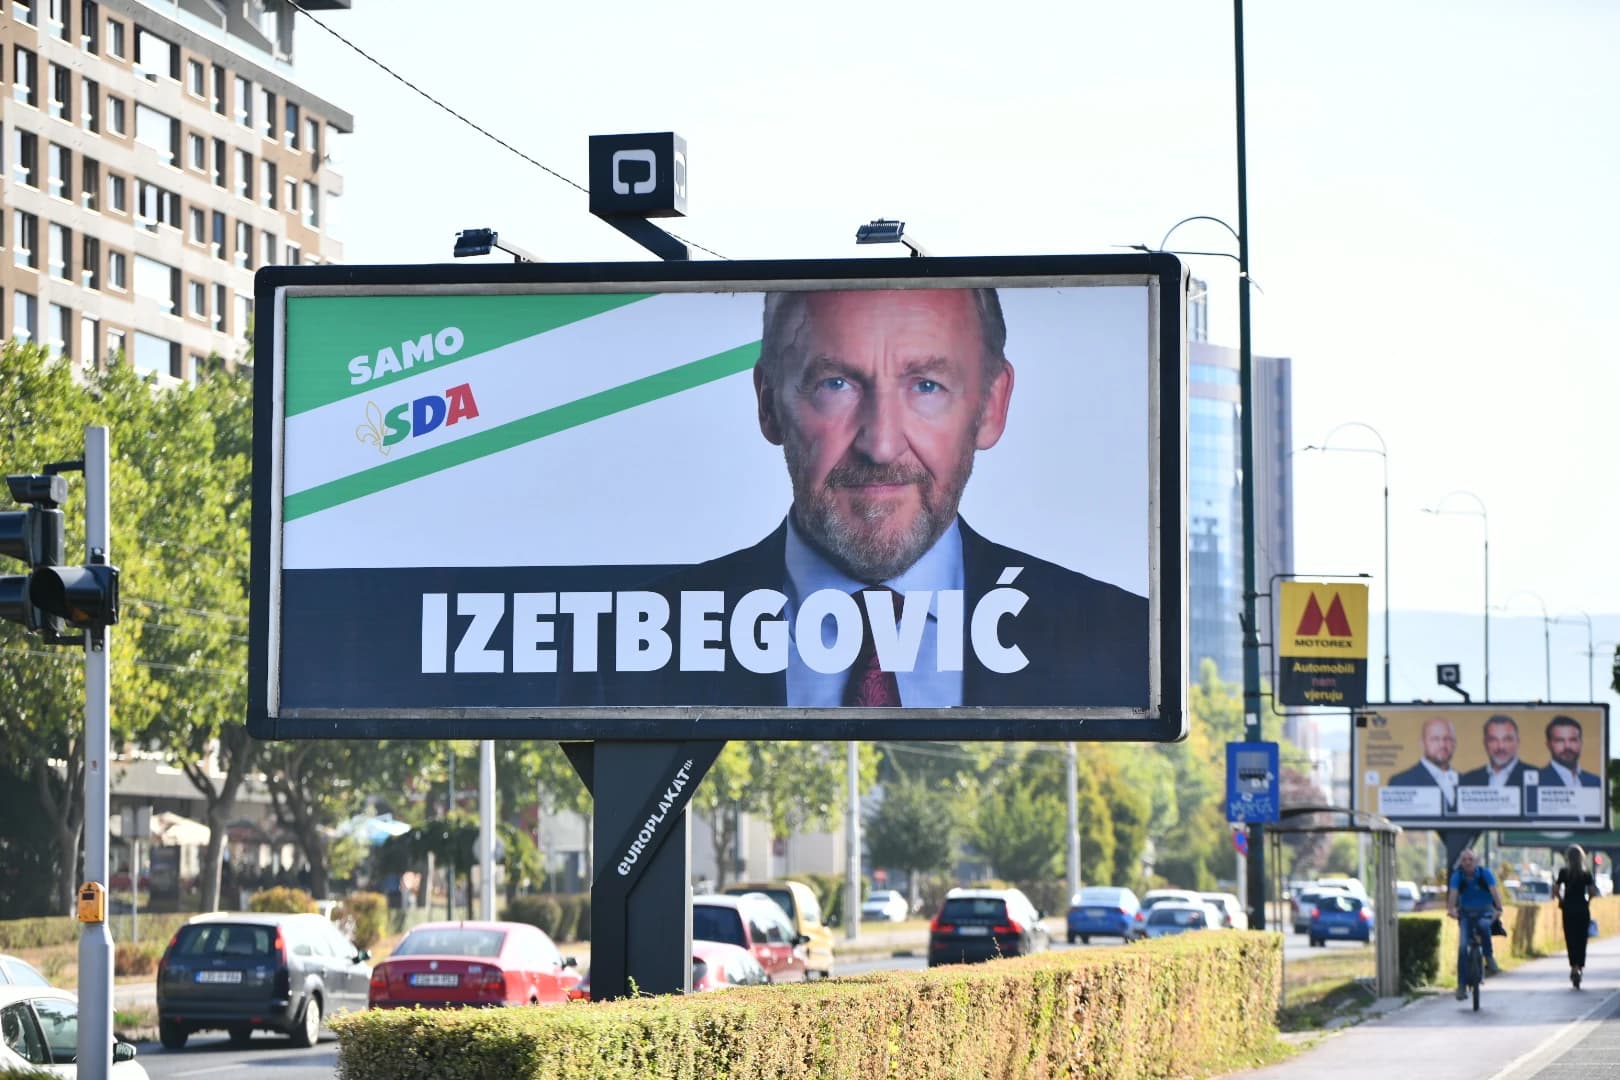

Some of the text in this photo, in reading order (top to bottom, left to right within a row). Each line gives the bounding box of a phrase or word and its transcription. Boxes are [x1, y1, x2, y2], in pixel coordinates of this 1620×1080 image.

[347, 326, 465, 385] SAMO
[382, 383, 480, 447] SDA
[421, 566, 1031, 674] IZETBEGOVIĆ
[1294, 639, 1353, 649] MOTOREX
[1292, 661, 1356, 674] Automobili
[1303, 689, 1344, 702] vjeruju
